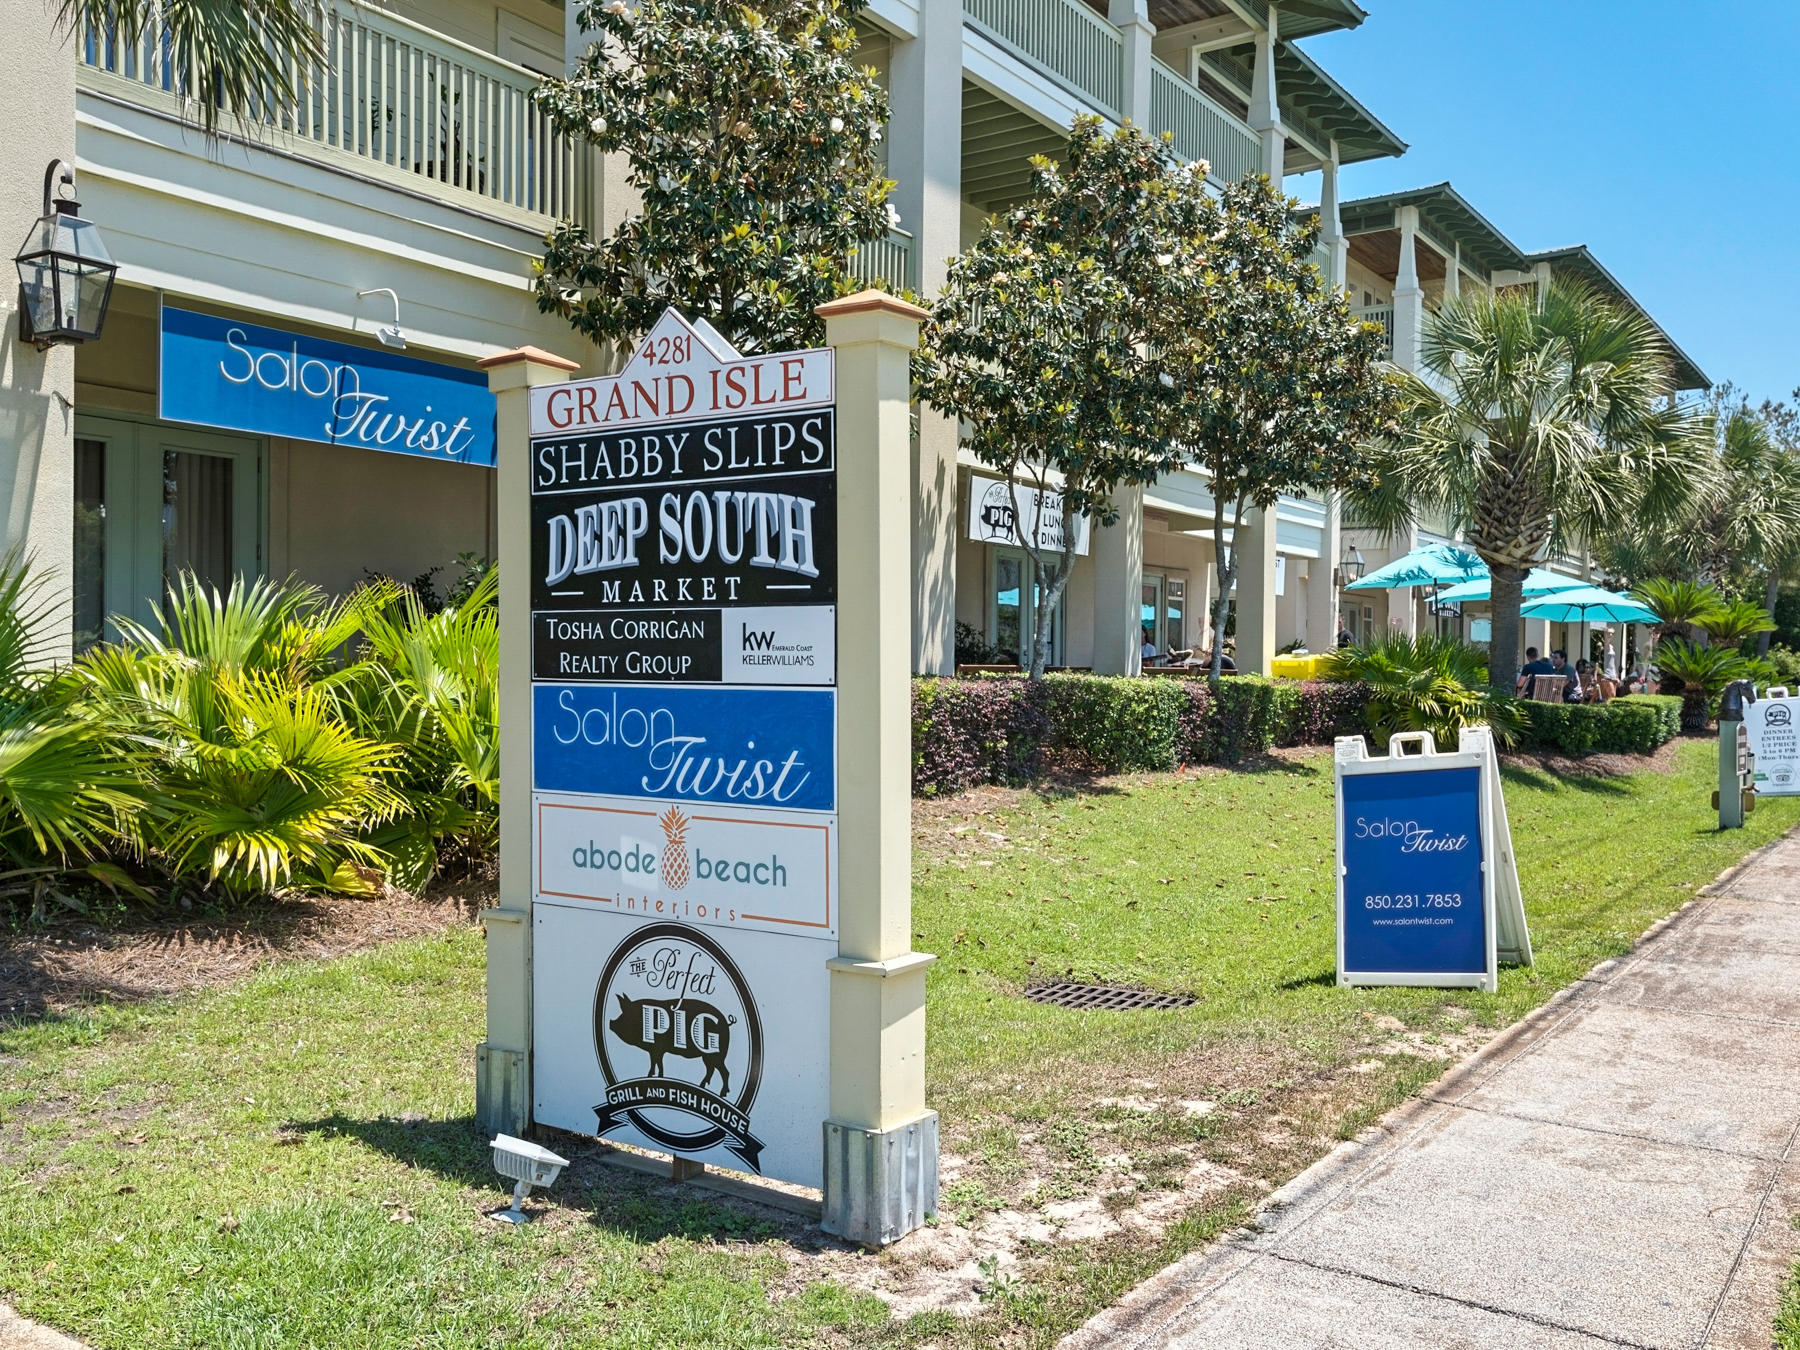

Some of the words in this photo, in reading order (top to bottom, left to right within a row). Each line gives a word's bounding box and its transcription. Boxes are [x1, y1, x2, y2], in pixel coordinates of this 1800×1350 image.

[220, 328, 360, 402] Salon
[642, 334, 692, 367] 4281
[546, 374, 695, 429] GRAND
[709, 359, 807, 411] ISLE
[324, 392, 476, 455] Twist
[538, 432, 689, 487] SHABBY
[703, 417, 824, 471] SLIPS
[990, 508, 1013, 527] PIG
[1034, 494, 1062, 511] BREAK
[1043, 513, 1063, 528] LUN
[545, 497, 649, 587] DEEP
[659, 490, 820, 578] SOUTH
[601, 576, 741, 603] MARKET
[546, 618, 604, 640] TOSHA
[610, 618, 704, 640] CORRIGAN
[742, 622, 776, 651] kw
[560, 652, 618, 674] REALTY
[626, 651, 691, 674] GROUP
[553, 689, 675, 747] Salon
[641, 736, 811, 801] Twist
[1355, 817, 1420, 838] Salon
[1401, 829, 1470, 853] Twist
[572, 839, 656, 875] abode
[696, 848, 787, 888] beach
[616, 893, 736, 921] interiors
[1365, 894, 1462, 909] 850.231.7853
[1373, 916, 1453, 926] www.salontwist.com
[630, 961, 646, 973] THE
[646, 947, 716, 1011] Perfect
[642, 1004, 721, 1053] PIG
[608, 1087, 644, 1105] GRILL
[646, 1087, 666, 1099] AND
[669, 1088, 698, 1108] FISH
[700, 1097, 748, 1135] HOUSE
